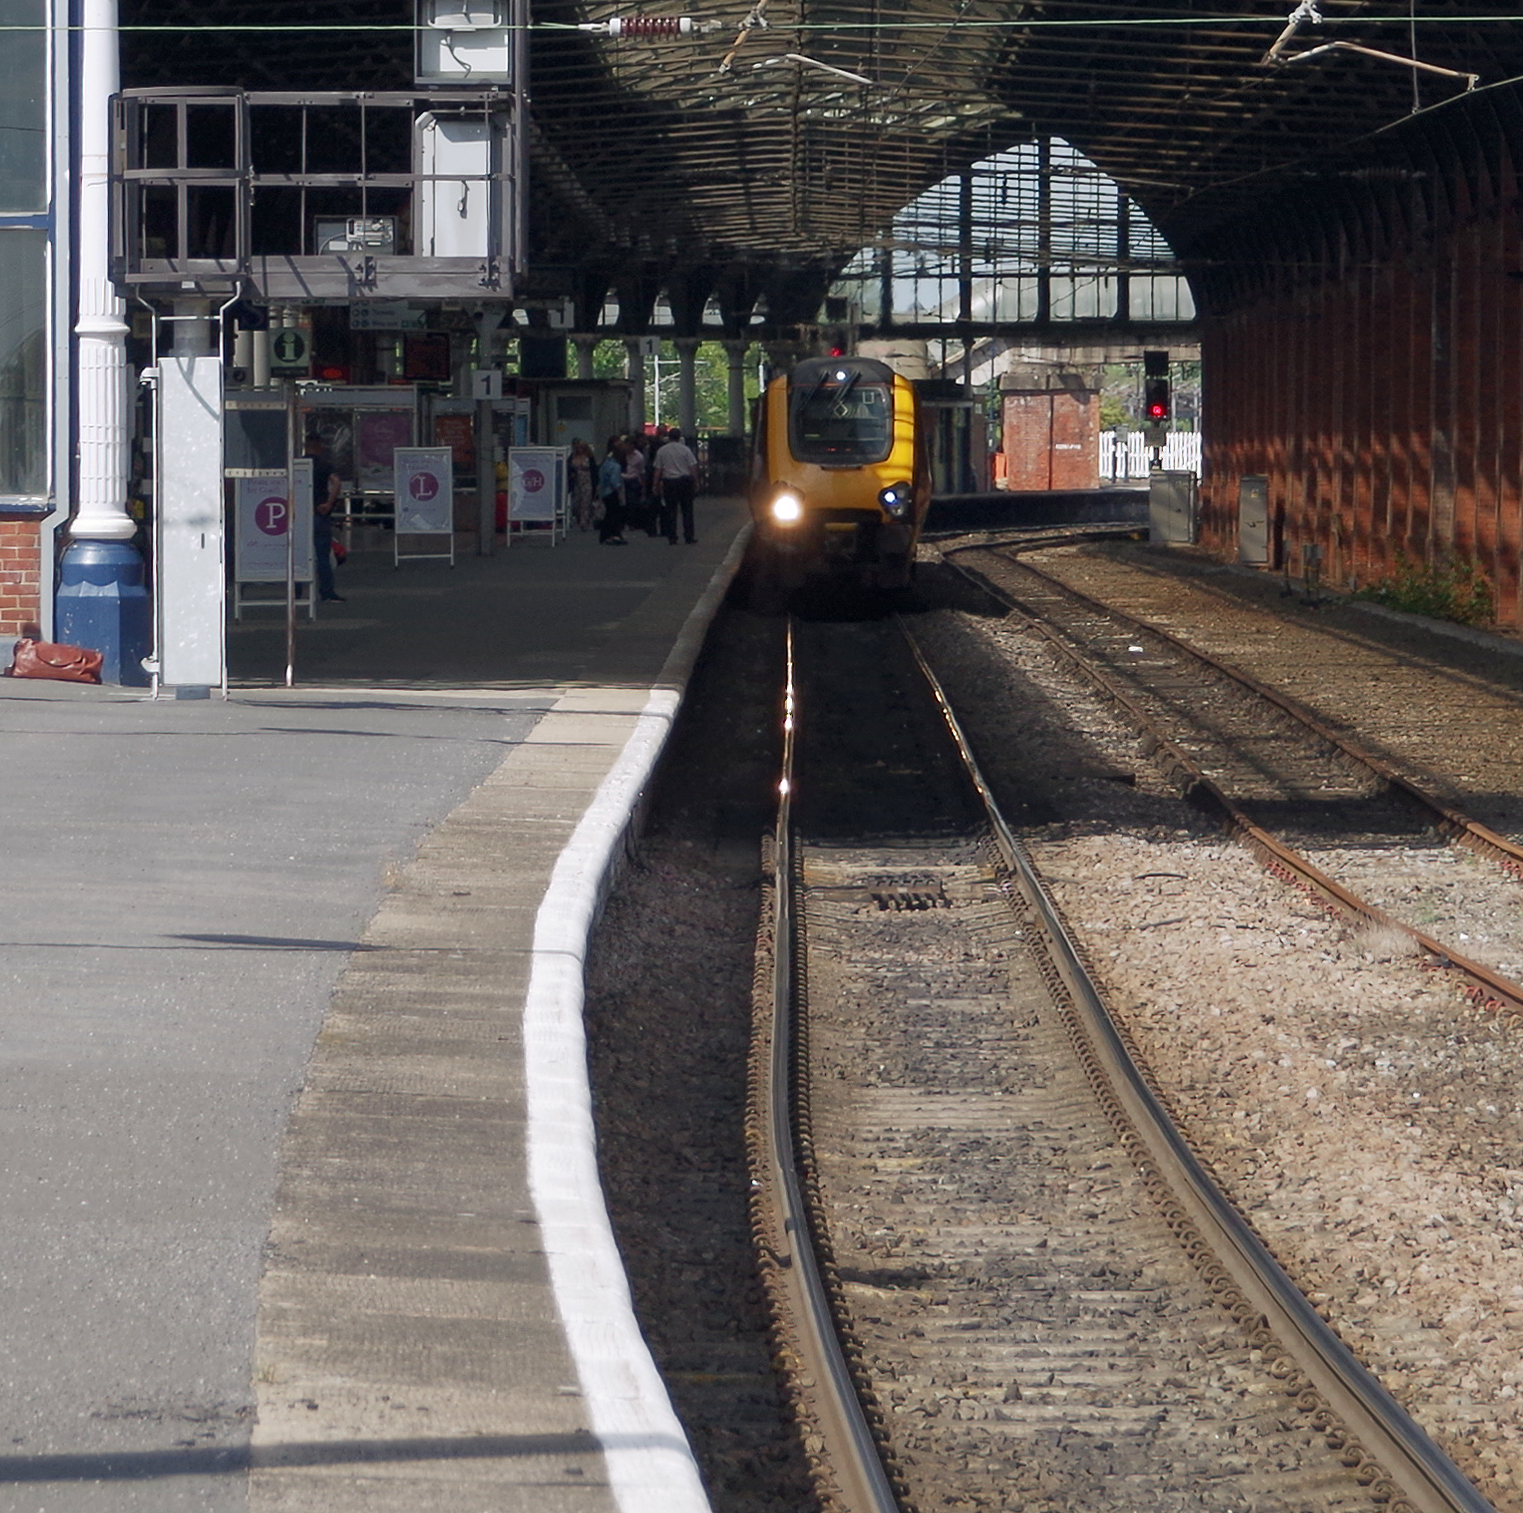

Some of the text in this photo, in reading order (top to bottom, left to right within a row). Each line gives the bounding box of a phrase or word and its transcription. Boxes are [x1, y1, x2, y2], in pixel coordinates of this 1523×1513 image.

[646, 339, 653, 353] 1
[481, 375, 491, 395] 1
[418, 476, 432, 496] L
[265, 502, 286, 529] P
